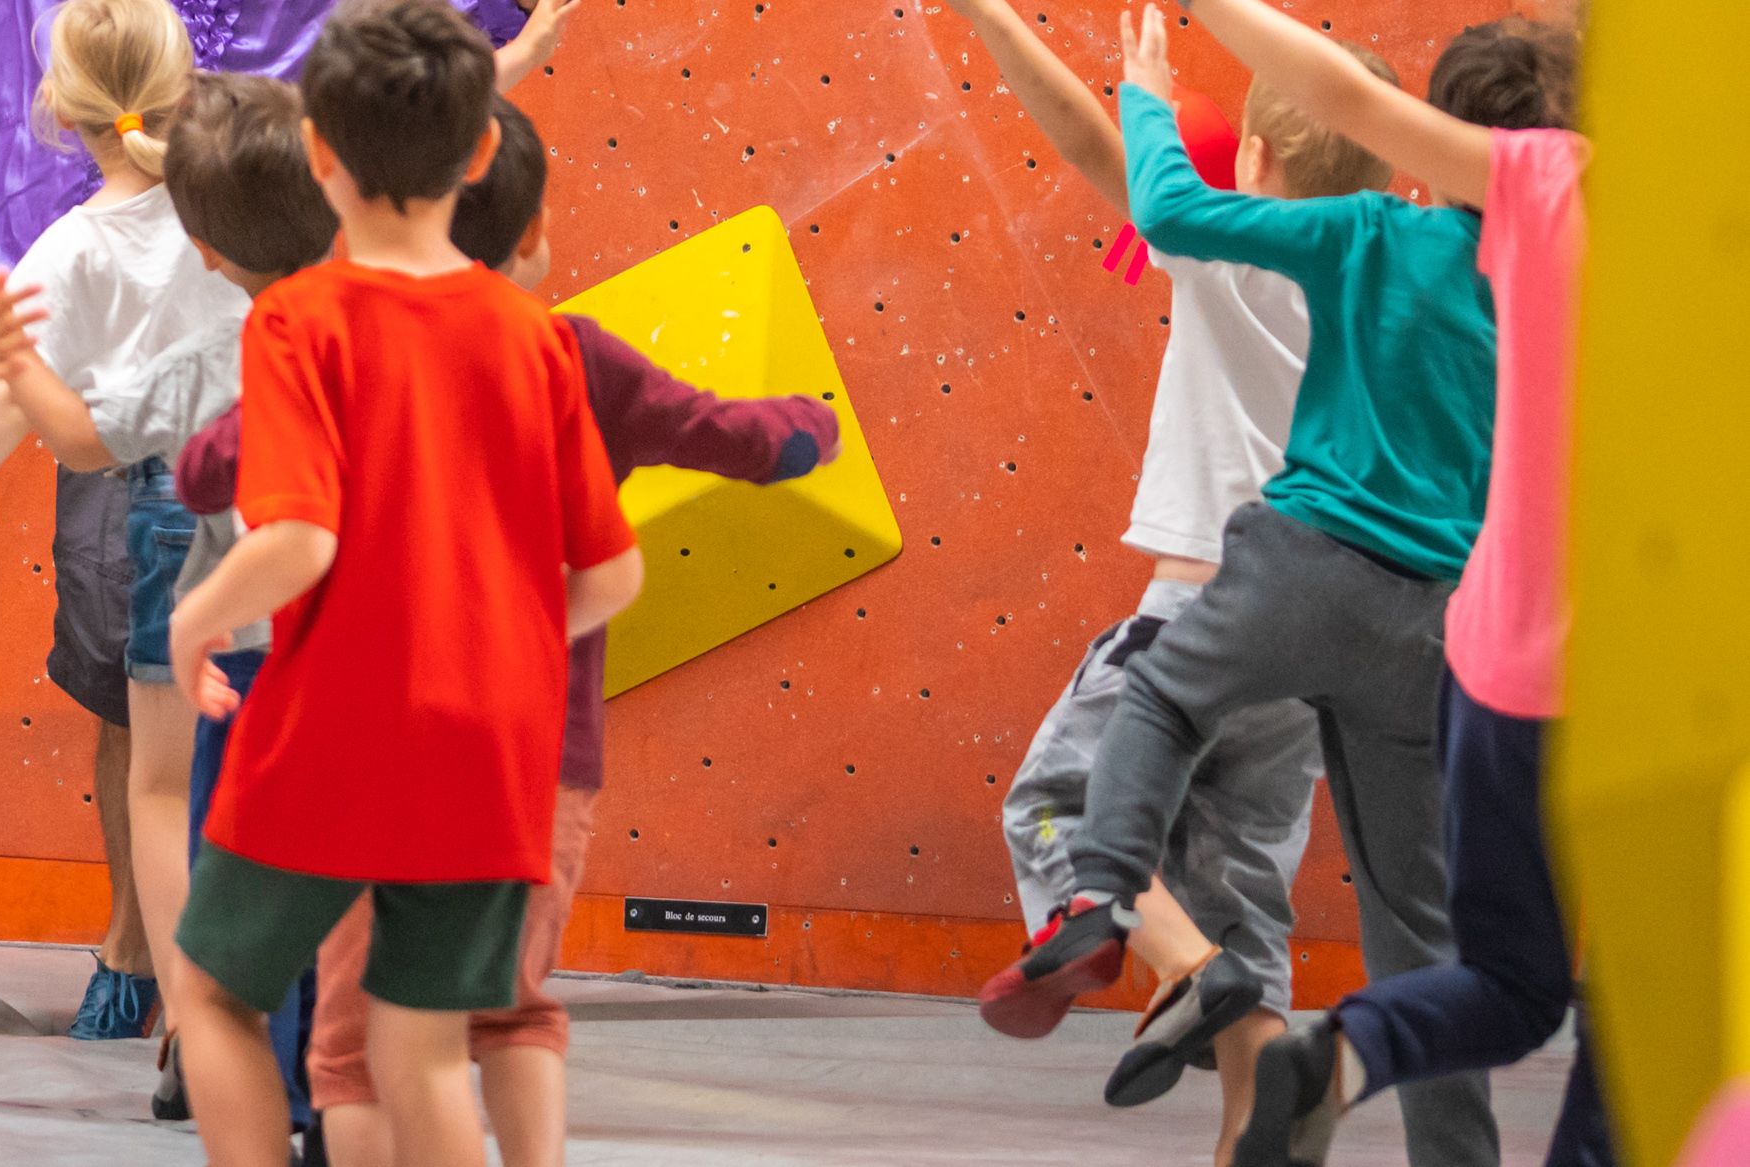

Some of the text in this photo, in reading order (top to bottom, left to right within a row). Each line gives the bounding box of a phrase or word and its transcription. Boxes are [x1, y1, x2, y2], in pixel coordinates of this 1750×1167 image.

[665, 910, 727, 923] Bloc de secours
